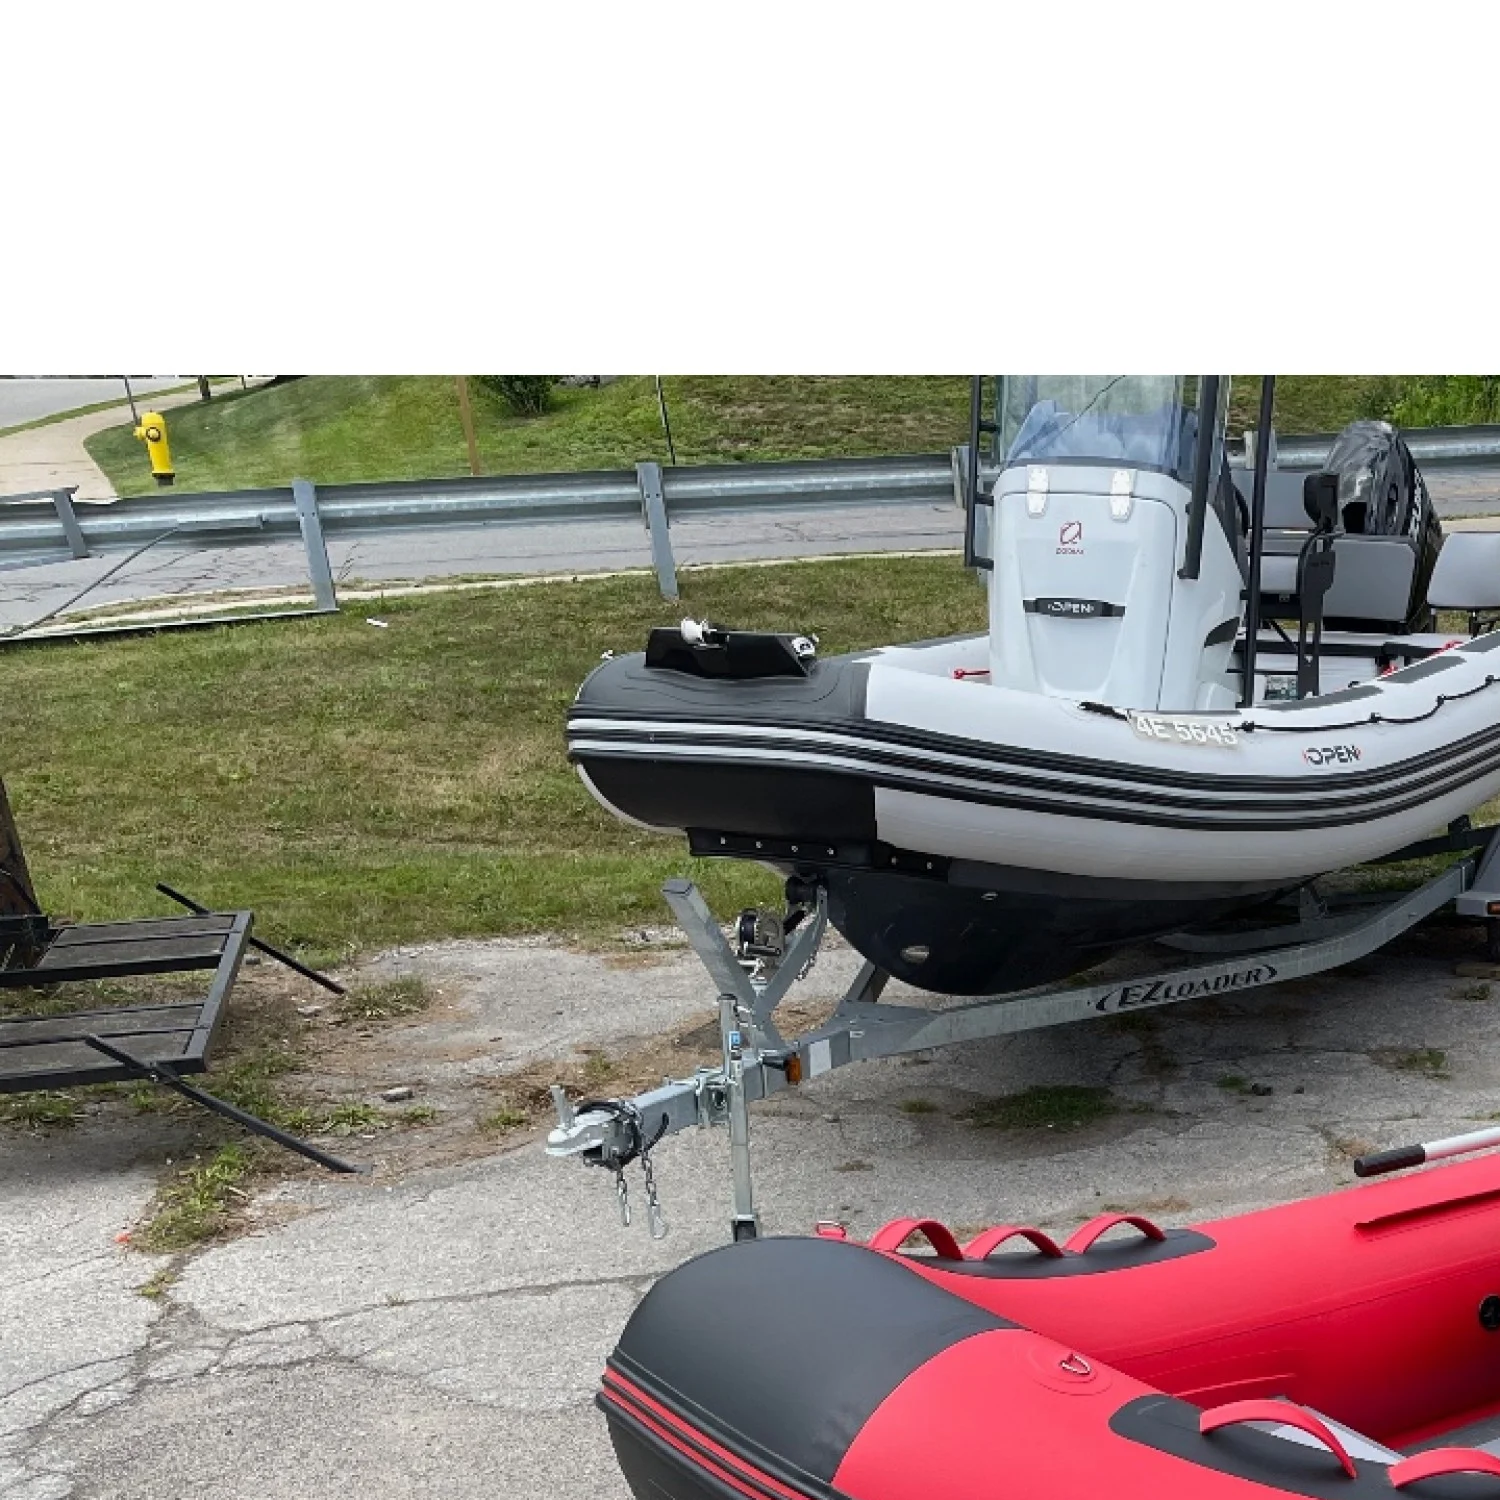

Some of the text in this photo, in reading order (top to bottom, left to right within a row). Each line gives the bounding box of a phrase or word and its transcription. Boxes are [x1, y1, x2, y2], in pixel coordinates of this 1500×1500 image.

[1050, 601, 1091, 613] OPEN
[1173, 720, 1239, 745] 5645
[1306, 745, 1360, 766] OPEN
